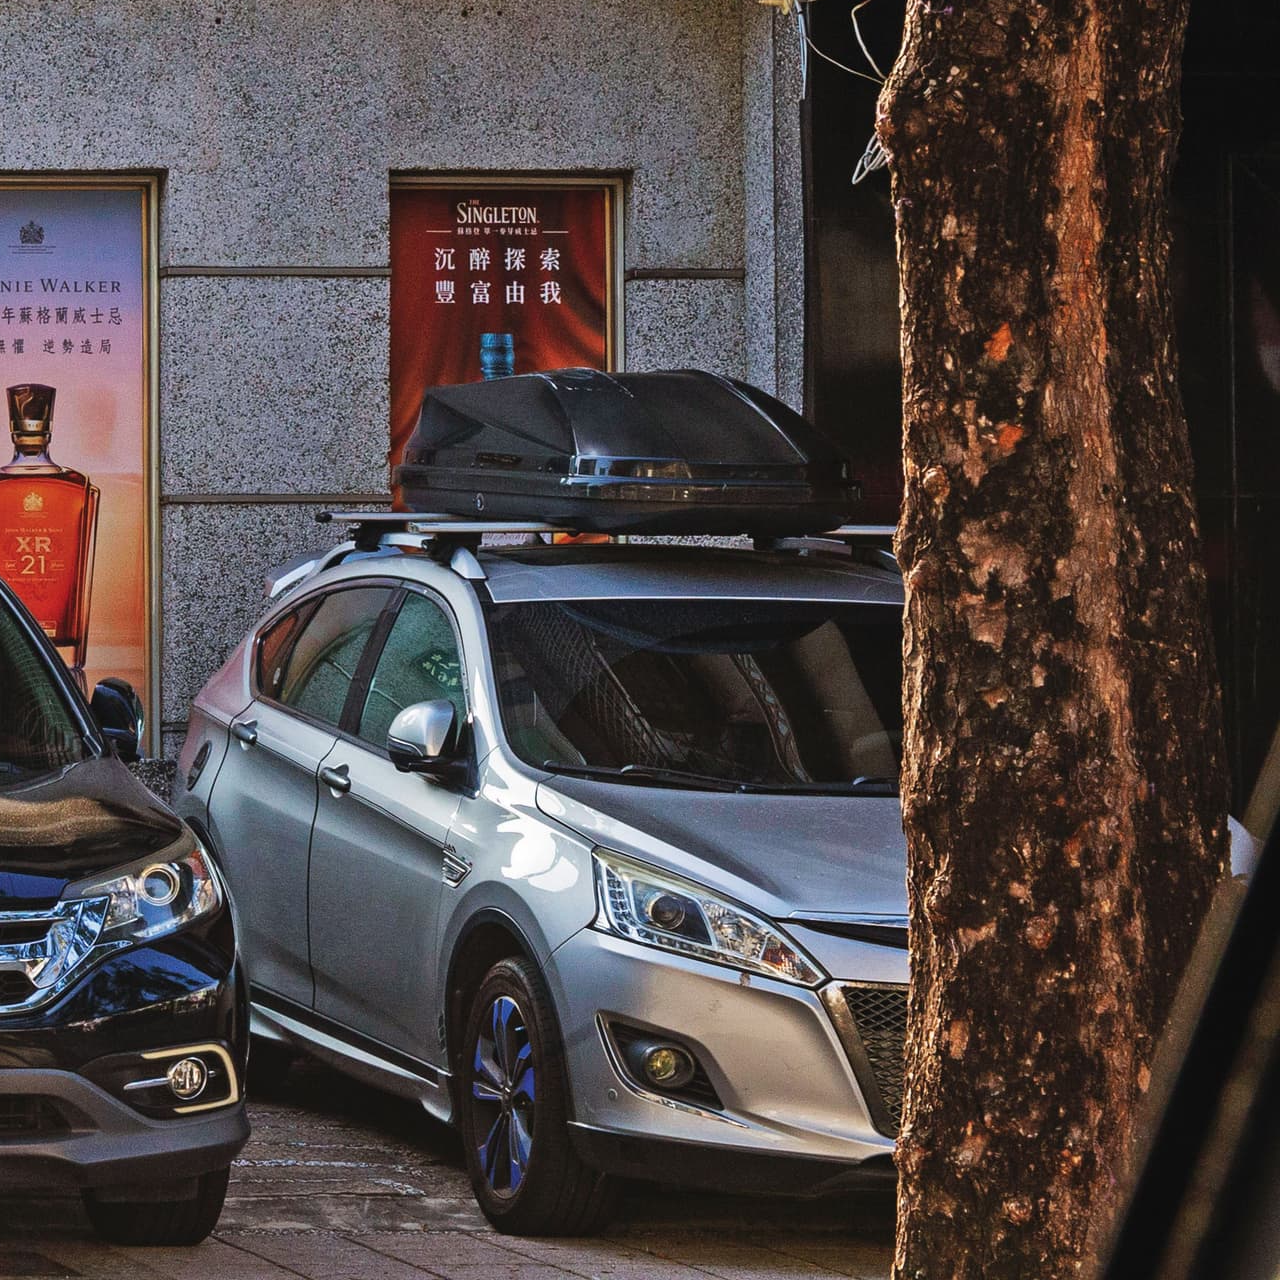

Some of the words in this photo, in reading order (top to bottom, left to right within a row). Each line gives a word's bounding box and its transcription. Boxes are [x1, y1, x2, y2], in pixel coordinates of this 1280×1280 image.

[456, 202, 538, 224] SINGLETON
[434, 247, 561, 271] 沉醉探索
[40, 278, 122, 294] WALKER
[434, 280, 562, 305] 豐富由我
[43, 337, 113, 355] 逆勢造局
[15, 536, 52, 553] XR
[20, 555, 45, 574] 21
